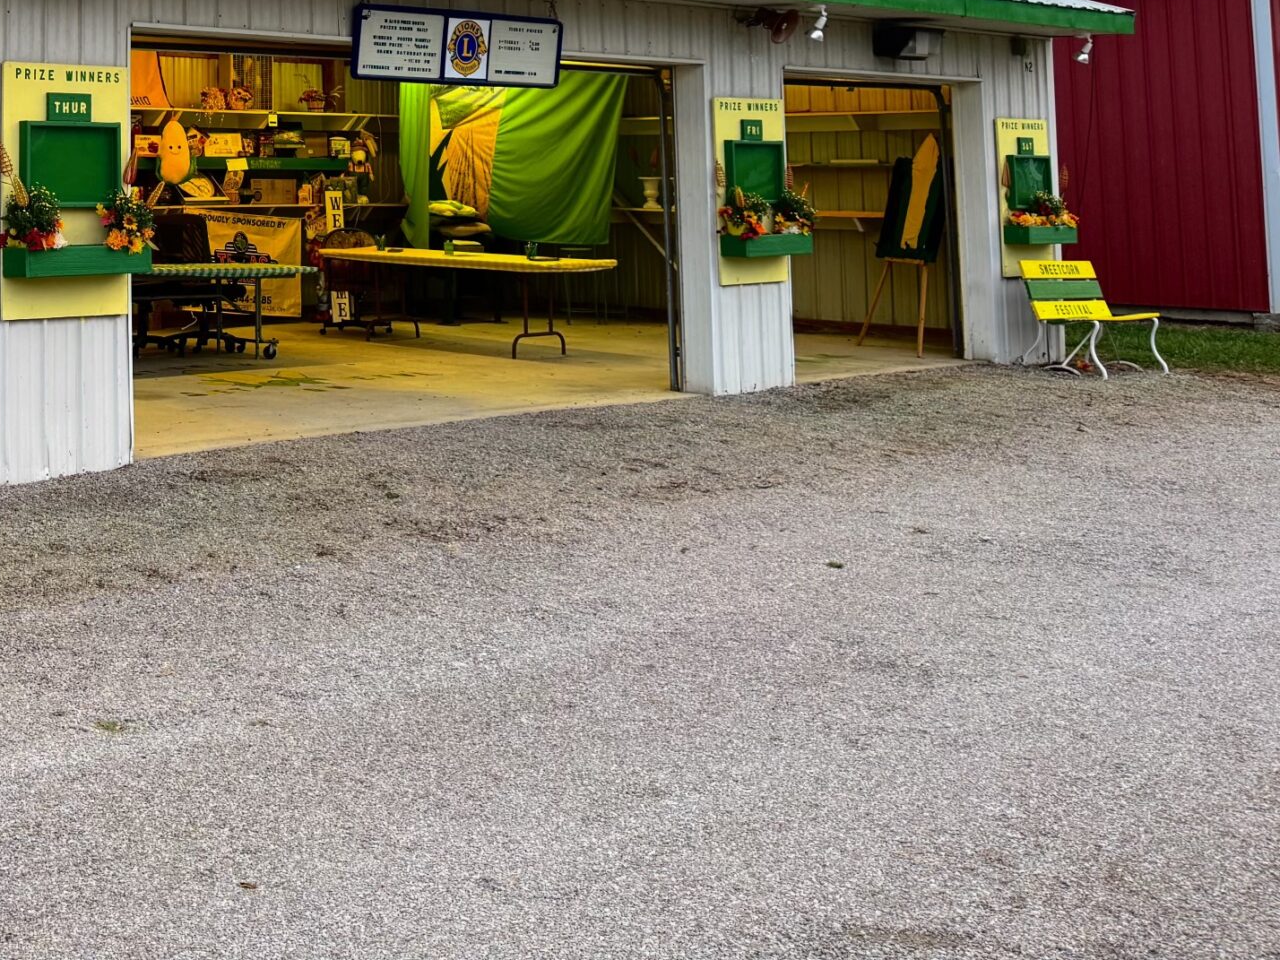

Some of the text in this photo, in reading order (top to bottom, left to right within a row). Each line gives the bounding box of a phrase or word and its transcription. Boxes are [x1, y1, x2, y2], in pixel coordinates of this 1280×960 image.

[457, 22, 480, 34] LIONS
[462, 38, 473, 57] L
[15, 67, 121, 83] PRIZE WINNERS
[54, 101, 87, 114] THUR
[719, 101, 778, 112] PRIZE WINNERS
[746, 125, 760, 135] FRI
[1001, 121, 1044, 131] PRIZE WINNERS
[232, 217, 276, 228] SPONSORED
[277, 221, 287, 229] BY
[1038, 263, 1081, 276] SWEETCORN
[1054, 304, 1094, 315] FESTIVAL
